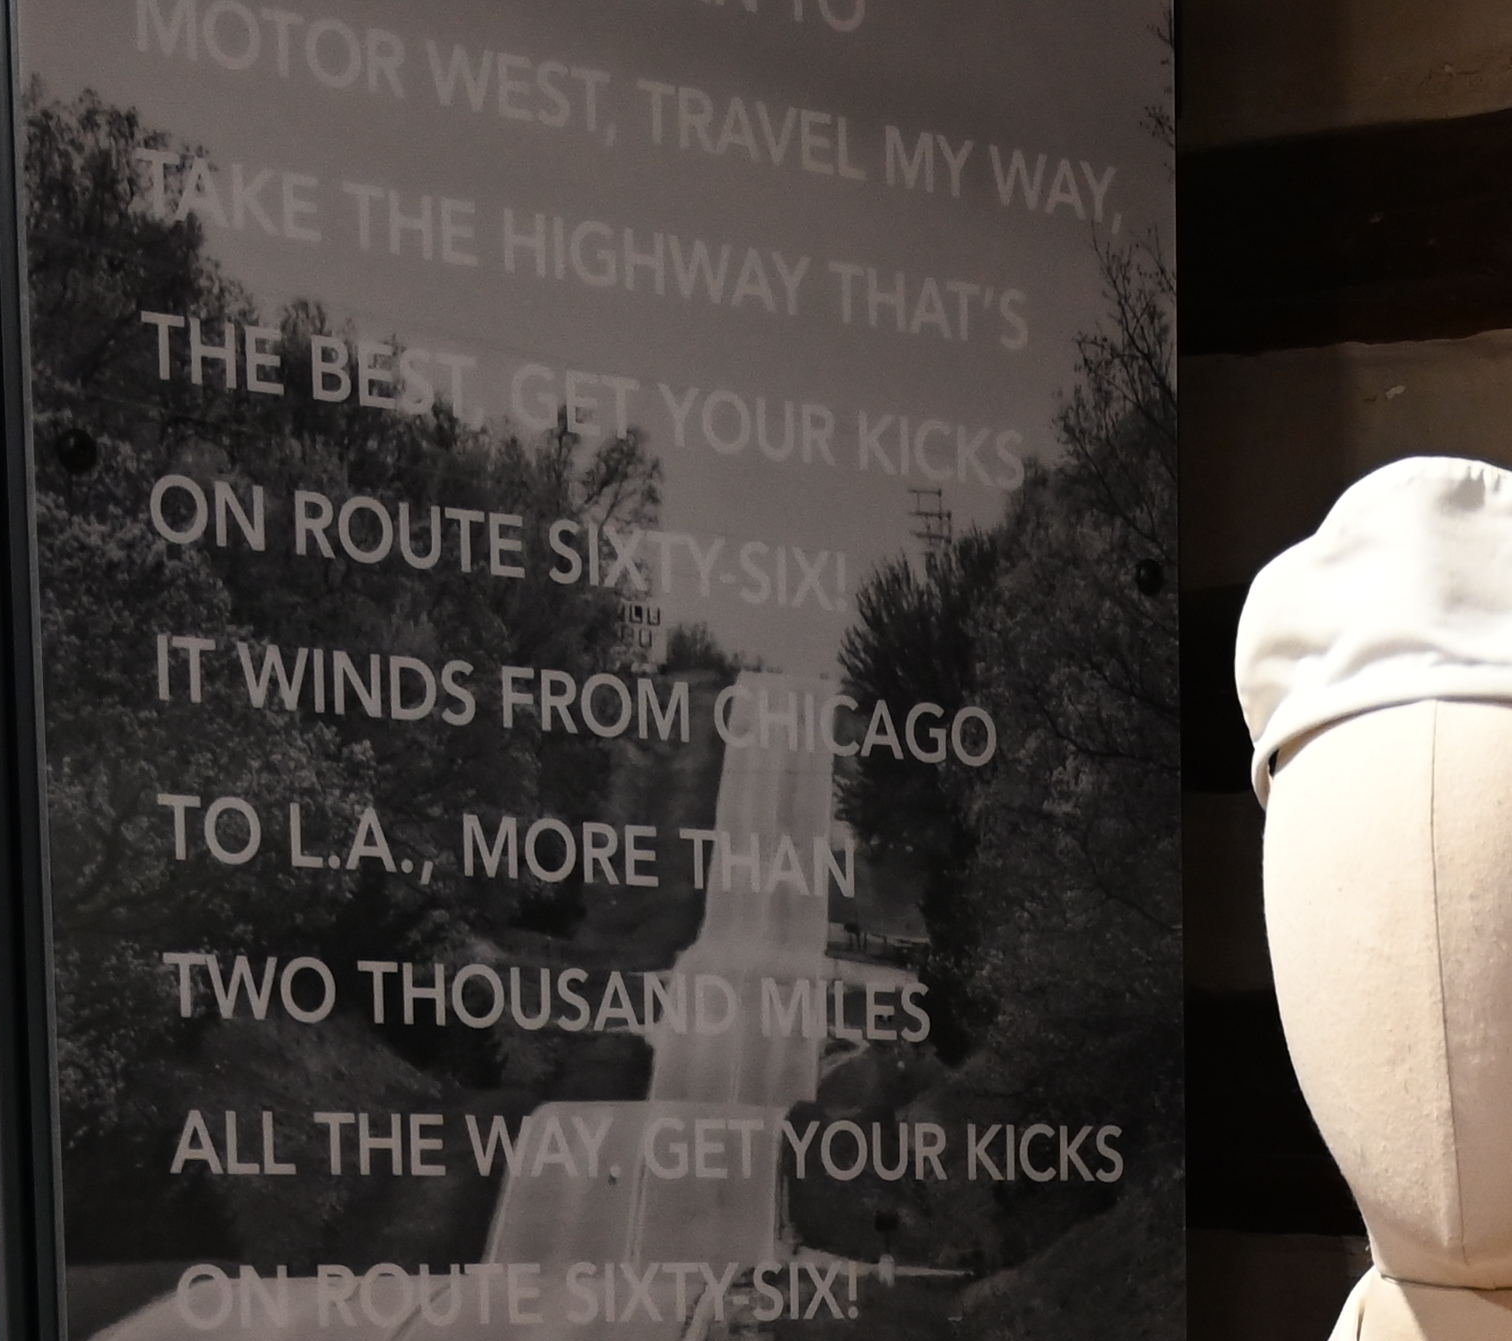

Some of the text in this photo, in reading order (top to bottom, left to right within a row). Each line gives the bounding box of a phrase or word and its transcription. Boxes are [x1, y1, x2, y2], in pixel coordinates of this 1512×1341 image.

[132, 0, 1126, 234] MOTOR WEST, TRAVEL MY WAY,
[134, 148, 1029, 352] TAKE THE HIGHWAY THAT'S
[141, 312, 286, 396] THE
[512, 363, 639, 438] GET
[659, 381, 836, 465] YOUR
[857, 408, 1025, 493] KICKS
[149, 475, 850, 615] ON ROUTE SIXTY-SIX!
[156, 635, 997, 768] IT WINDS FROM CHICAGO
[157, 792, 856, 900] TO L.A., MORE THAN
[162, 951, 931, 1044] TWO THOUSAND MILES
[171, 1108, 1124, 1186] ALL THE WAY. GET YOUR KICKS
[175, 1260, 860, 1331] ON ROUTE SIXTY-SIX!
